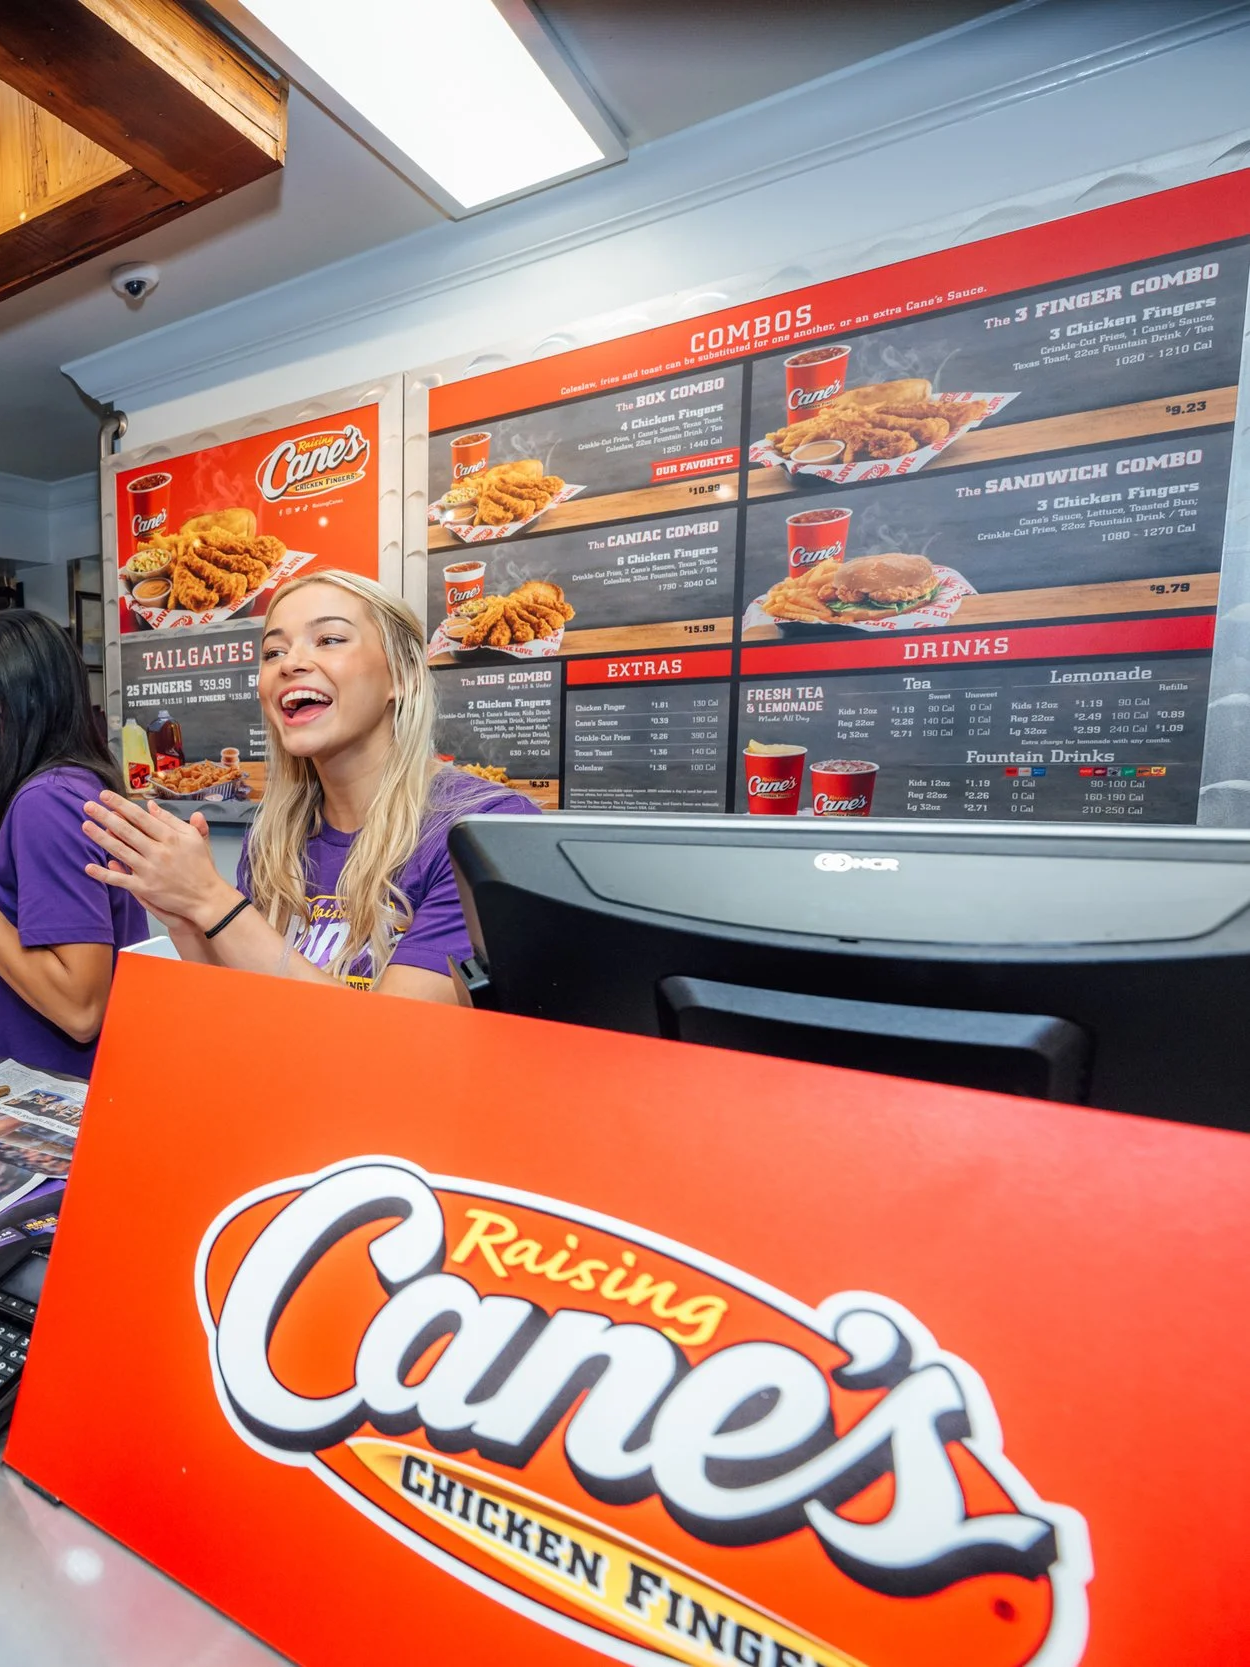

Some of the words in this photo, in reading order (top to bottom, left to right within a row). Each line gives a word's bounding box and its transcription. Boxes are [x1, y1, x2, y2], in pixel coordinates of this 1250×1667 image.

[984, 317, 1011, 331] The
[1014, 307, 1028, 323] 3
[1035, 285, 1123, 318] FINGER
[1130, 262, 1220, 296] COMBO
[690, 304, 812, 354] COMBOS
[1049, 328, 1060, 341] 3
[1066, 315, 1137, 337] Chicken
[1143, 297, 1217, 322] Fingers
[560, 381, 598, 396] Coleslaw,
[600, 375, 619, 386] fries
[622, 370, 638, 381] and
[641, 364, 663, 376] toast
[665, 361, 681, 371] can
[684, 355, 695, 366] be
[698, 341, 751, 364] substituted
[753, 337, 769, 349] for
[772, 333, 790, 344] one
[793, 323, 836, 339] another,
[840, 320, 851, 331] or
[855, 314, 869, 325] an
[873, 307, 902, 321] extra
[906, 295, 943, 312] Cane's
[947, 286, 987, 302] Sauce.
[1040, 339, 1097, 356] Crinkle-Cut
[1099, 332, 1128, 347] Fries,
[1141, 320, 1175, 335] Cane's
[1179, 313, 1215, 329] Sauce,
[1013, 360, 1040, 372] Texas
[1043, 352, 1071, 365] Toast,
[1074, 347, 1100, 360] 22oz
[1103, 337, 1148, 354] Fountain
[1151, 330, 1181, 345] Drink
[1195, 323, 1214, 336] Tea
[1116, 352, 1145, 368] 1020
[1159, 344, 1190, 361] 1210
[1193, 340, 1213, 353] Cal
[615, 401, 634, 413] The
[636, 390, 666, 408] BOX
[670, 377, 726, 400] COMBO
[788, 379, 842, 410] Cane's
[620, 422, 628, 432] 4
[631, 413, 675, 429] Chicken
[678, 403, 724, 421] Fingers
[1165, 401, 1207, 417] $9.23
[297, 436, 334, 453] Raising
[663, 445, 681, 456] 1250
[261, 426, 368, 499] Cane's
[454, 458, 487, 480] Cane's
[656, 463, 678, 477] OUR
[679, 453, 734, 474] FAVORITE
[295, 477, 324, 492] CHICKEN
[325, 470, 356, 487] FINGERS
[956, 487, 981, 499] The
[984, 462, 1108, 495] SANDWICH
[1115, 449, 1203, 475] COMBO
[689, 484, 721, 496] $10.99
[1037, 499, 1048, 511] 3
[1053, 491, 1122, 509] Chicken
[1127, 482, 1200, 503] Fingers
[132, 508, 168, 537] Cane's
[977, 528, 1029, 542] Crinkle-Cut
[1032, 524, 1058, 538] Fries,
[1061, 521, 1085, 534] 22oz
[1088, 515, 1132, 530] Fountain
[1136, 510, 1164, 524] Drink
[1178, 507, 1197, 518] Tea
[1019, 514, 1049, 527] Cane's
[1051, 510, 1083, 525] Sauce,
[1087, 506, 1126, 522] Lettuce,
[1129, 500, 1170, 514] Toasted
[588, 541, 605, 550] The
[607, 528, 661, 548] CANIAC
[665, 520, 719, 540] COMBO
[1101, 529, 1130, 542] 1080
[1143, 524, 1173, 539] 1270
[1176, 521, 1196, 534] Cal
[617, 557, 625, 567] 6
[627, 549, 671, 564] Chicken
[673, 546, 719, 561] Fingers
[790, 540, 842, 567] Cane's
[447, 584, 481, 605] Cane's
[1149, 582, 1191, 598] $9.79
[683, 624, 715, 635] $15.99
[142, 641, 256, 671] TAILGATES
[903, 637, 1010, 661] DRINKS
[461, 678, 475, 687] The
[476, 674, 505, 686] KIDS
[508, 671, 552, 684] COMBO
[607, 659, 682, 679] EXTRAS
[1050, 666, 1152, 685] Lemonade
[127, 684, 140, 697] 25
[142, 680, 193, 697] FINGERS
[200, 678, 232, 692] $39.99
[746, 687, 791, 701] FRESH
[796, 686, 825, 700] TEA
[902, 677, 932, 691] Tea
[1158, 682, 1189, 692] Refills
[476, 699, 513, 710] Chicken
[514, 698, 552, 709] Fingers
[746, 703, 755, 715] &
[758, 701, 824, 715] LEMONADE
[1011, 702, 1032, 711] Kids
[1036, 701, 1059, 710] 12oz
[1134, 697, 1151, 706] Cal
[1010, 714, 1029, 724] Reg
[1133, 711, 1150, 721] Cal
[1132, 723, 1149, 734] Cal
[966, 750, 1044, 764] Fountain
[1050, 748, 1115, 764] Drinks
[748, 775, 797, 796] Cane's
[814, 793, 869, 814] Cane's
[449, 1207, 731, 1349] Raising
[9, 1350, 18, 1359] 6
[214, 1160, 1062, 1602] Cane's
[400, 1452, 606, 1602] CHICKEN
[625, 1562, 835, 1667] FINGE
